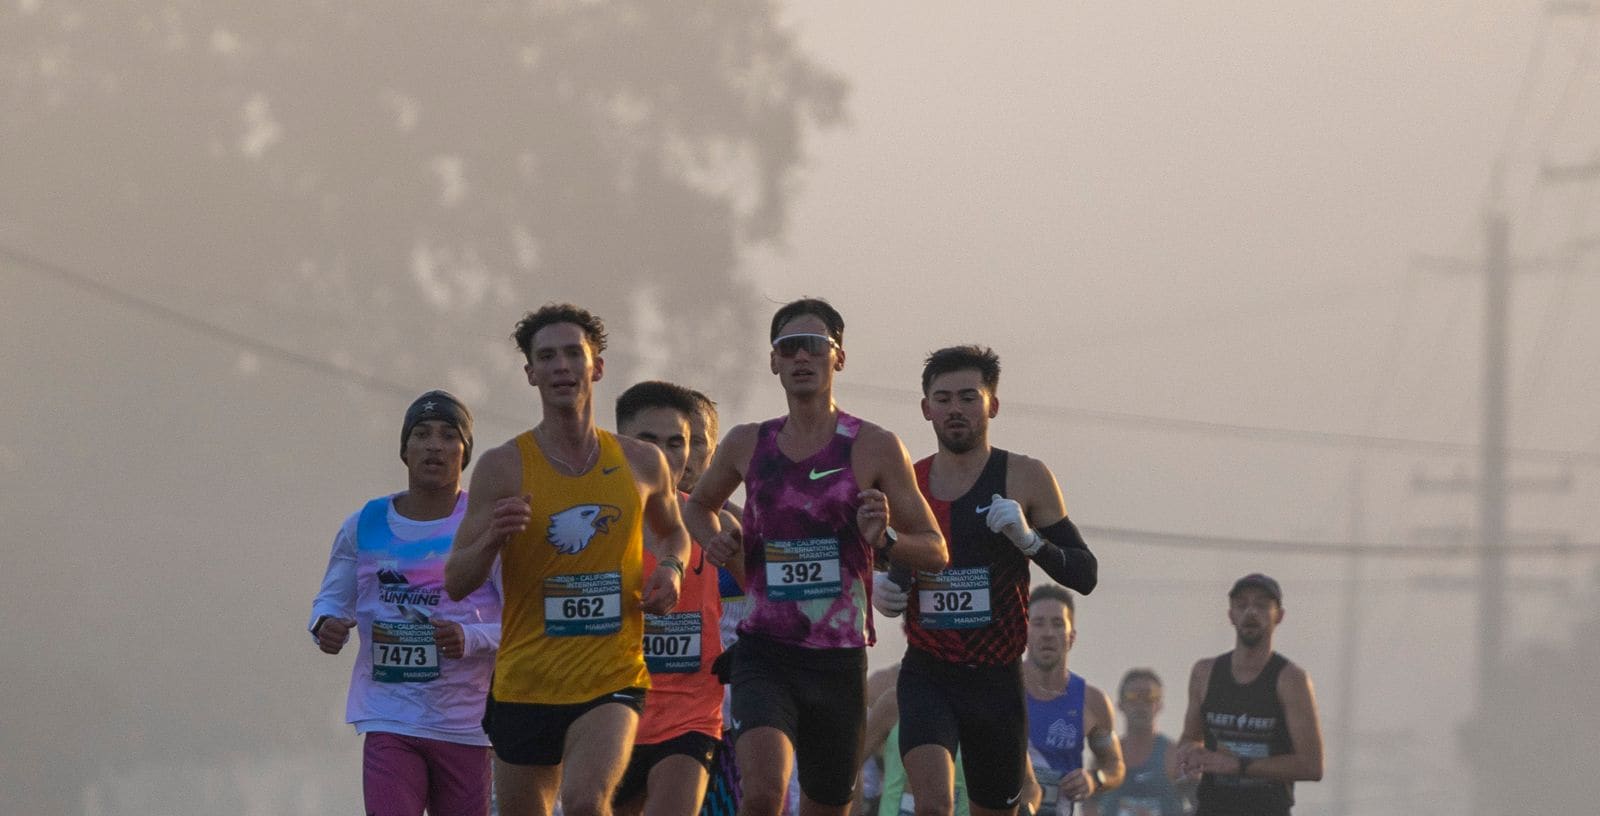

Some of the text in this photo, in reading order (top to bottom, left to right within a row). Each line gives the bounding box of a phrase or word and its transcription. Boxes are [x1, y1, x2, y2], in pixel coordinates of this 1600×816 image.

[797, 538, 839, 547] CALIFORNIA
[783, 545, 839, 554] INTERNATIONAL
[799, 551, 839, 560] MARATHON
[781, 562, 823, 584] 392
[948, 568, 989, 576] CALIFORNIA
[935, 574, 988, 583] INTERNATIONAL
[565, 579, 620, 589] INTERNATIONAL
[950, 580, 990, 589] MARATHON
[582, 585, 621, 594] MARATHON
[803, 587, 842, 596] MARATHON
[933, 591, 973, 612] 302
[562, 596, 605, 619] 662
[953, 616, 991, 625] MARATHON
[643, 635, 692, 656] 4007
[379, 645, 427, 666] 7473
[403, 671, 439, 679] MARATHON
